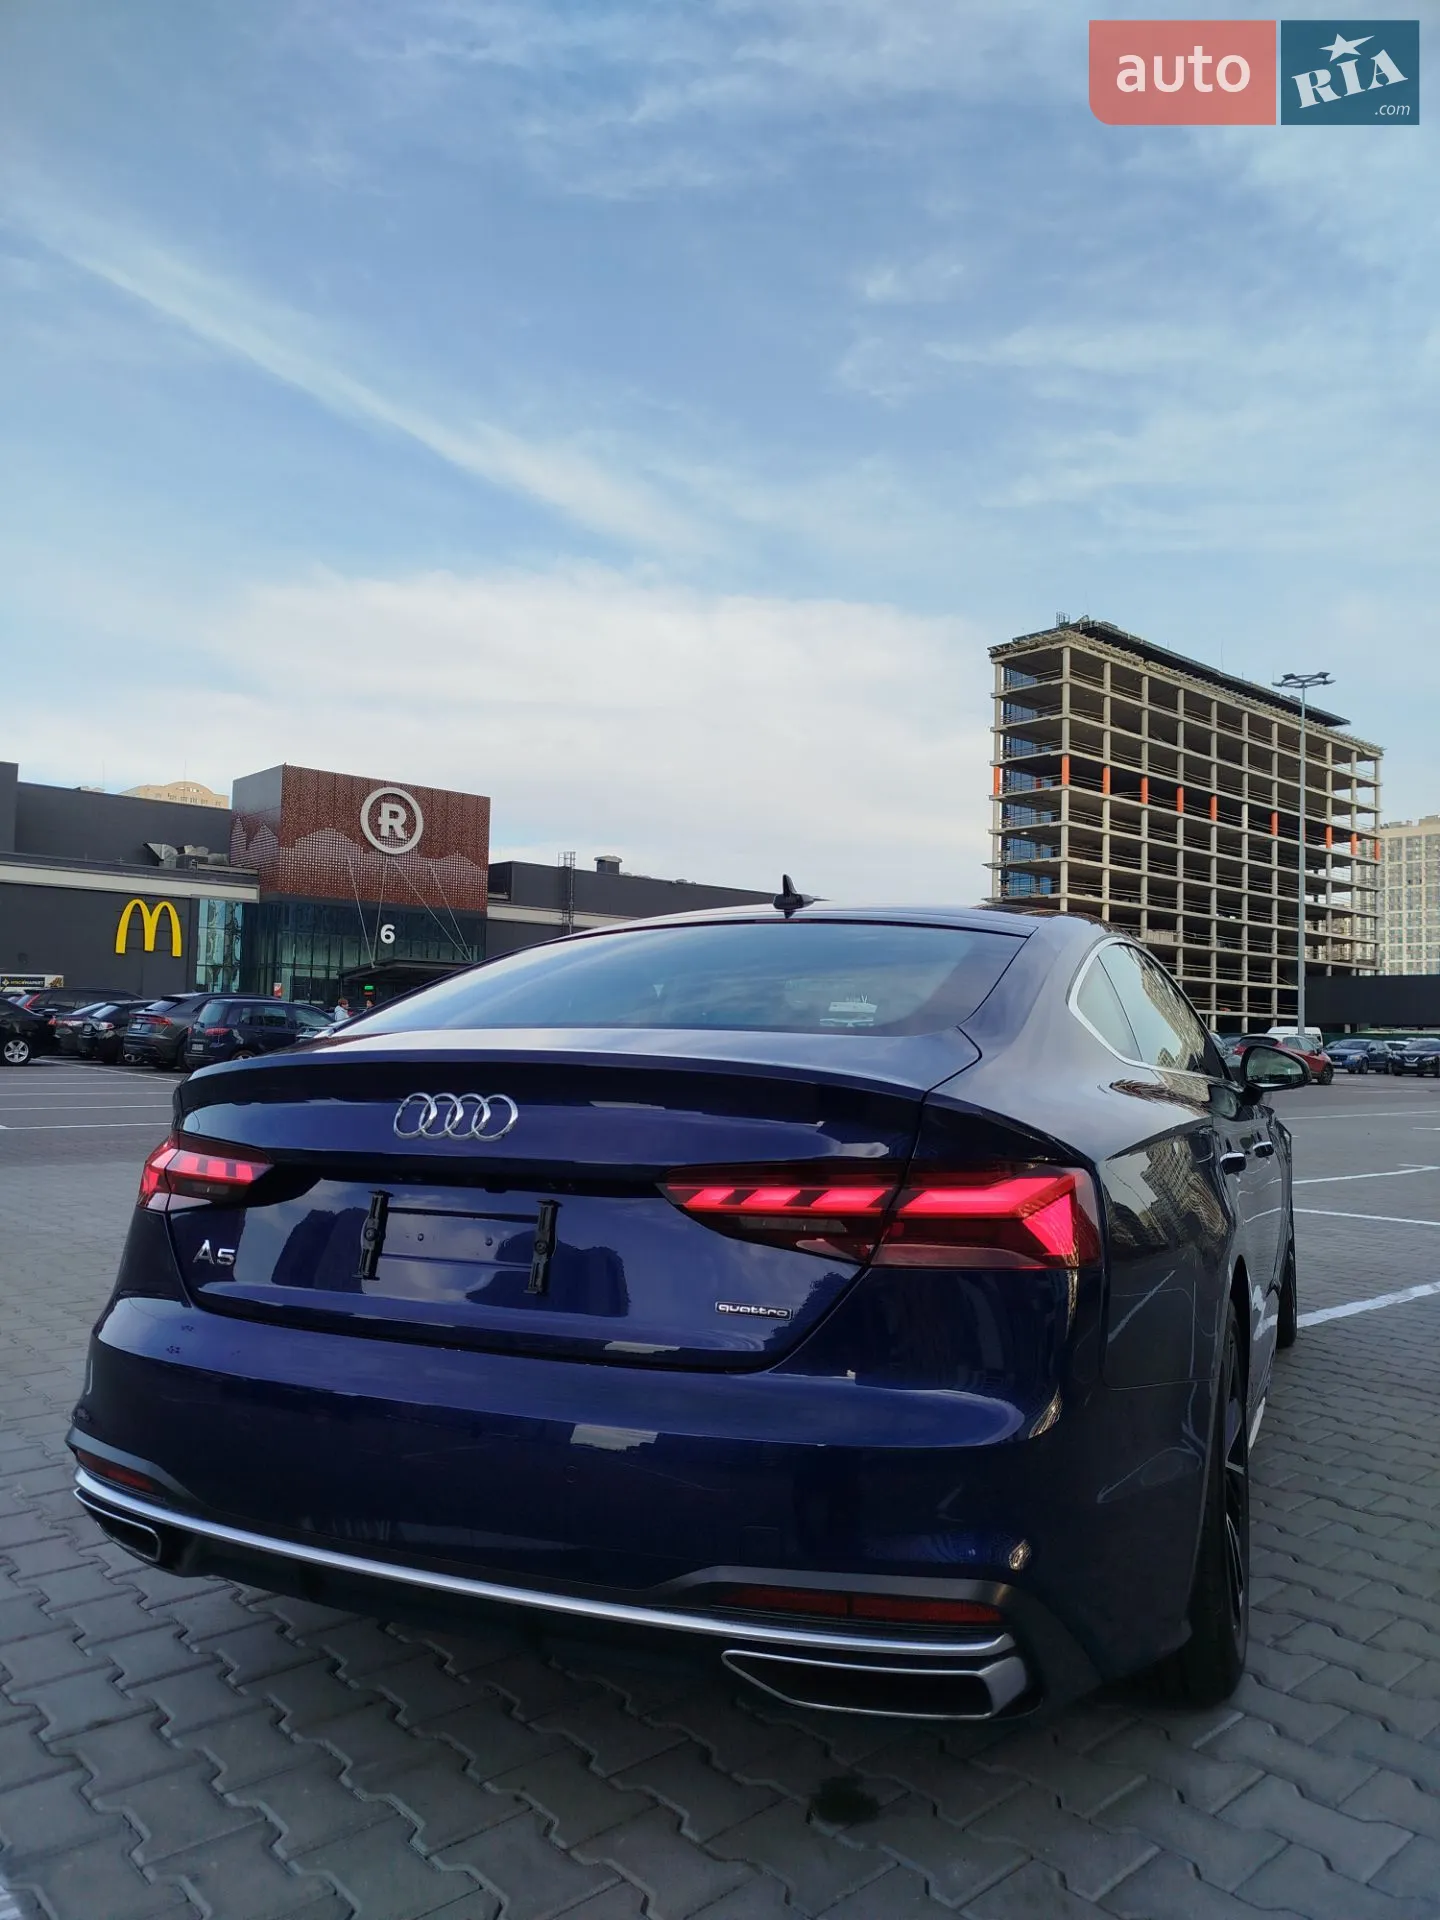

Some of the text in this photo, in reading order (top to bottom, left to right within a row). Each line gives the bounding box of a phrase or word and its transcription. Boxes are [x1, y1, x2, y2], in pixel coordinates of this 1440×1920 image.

[380, 923, 396, 944] 6
[192, 1239, 235, 1266] A5
[718, 1304, 788, 1317] quattro
